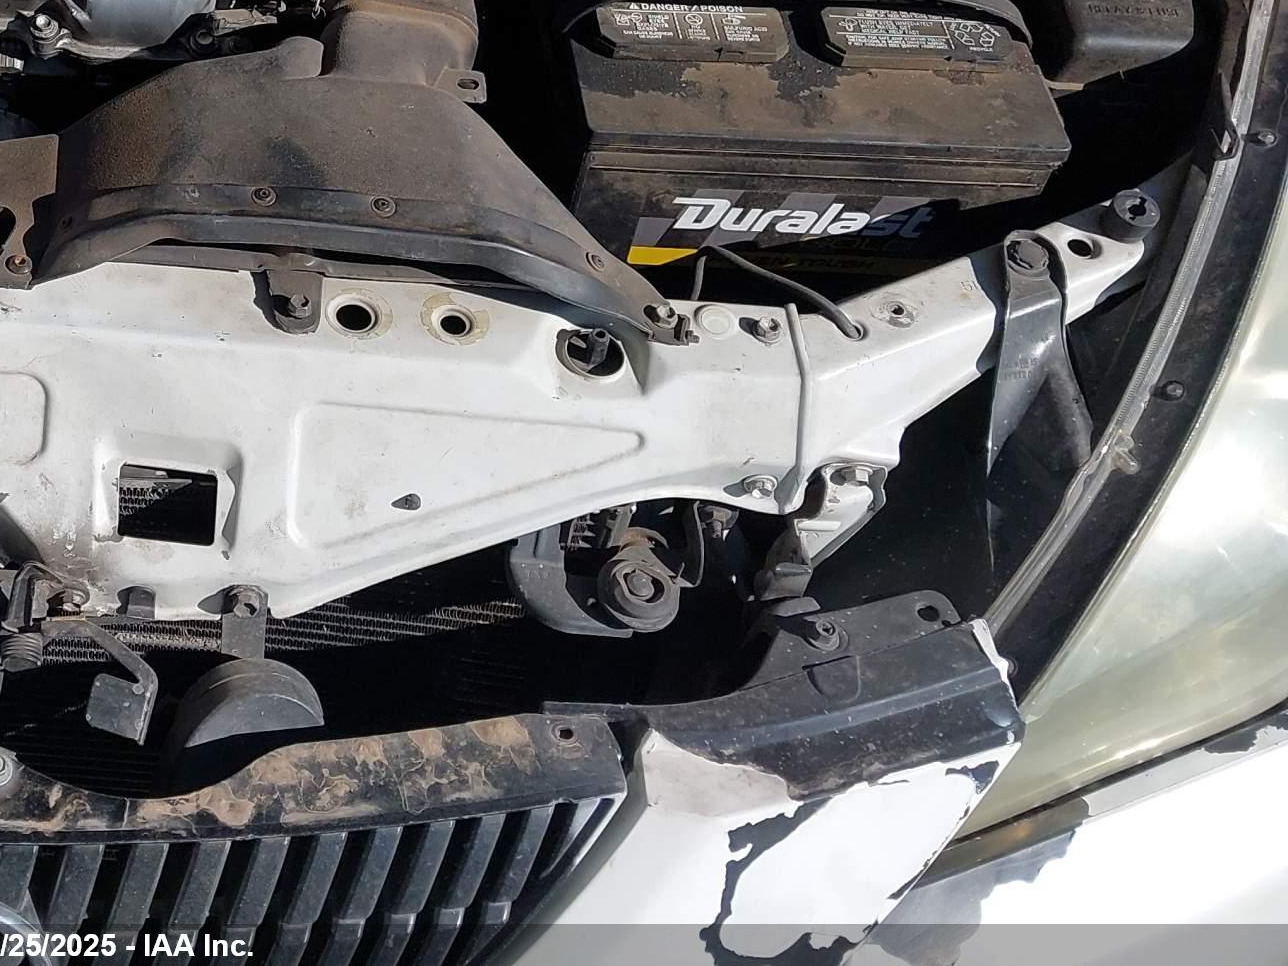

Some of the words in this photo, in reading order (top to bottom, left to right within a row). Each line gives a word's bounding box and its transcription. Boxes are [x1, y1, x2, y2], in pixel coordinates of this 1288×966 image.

[641, 3, 687, 12] DANGER
[701, 5, 744, 13] POISON
[672, 197, 935, 239] Duralast
